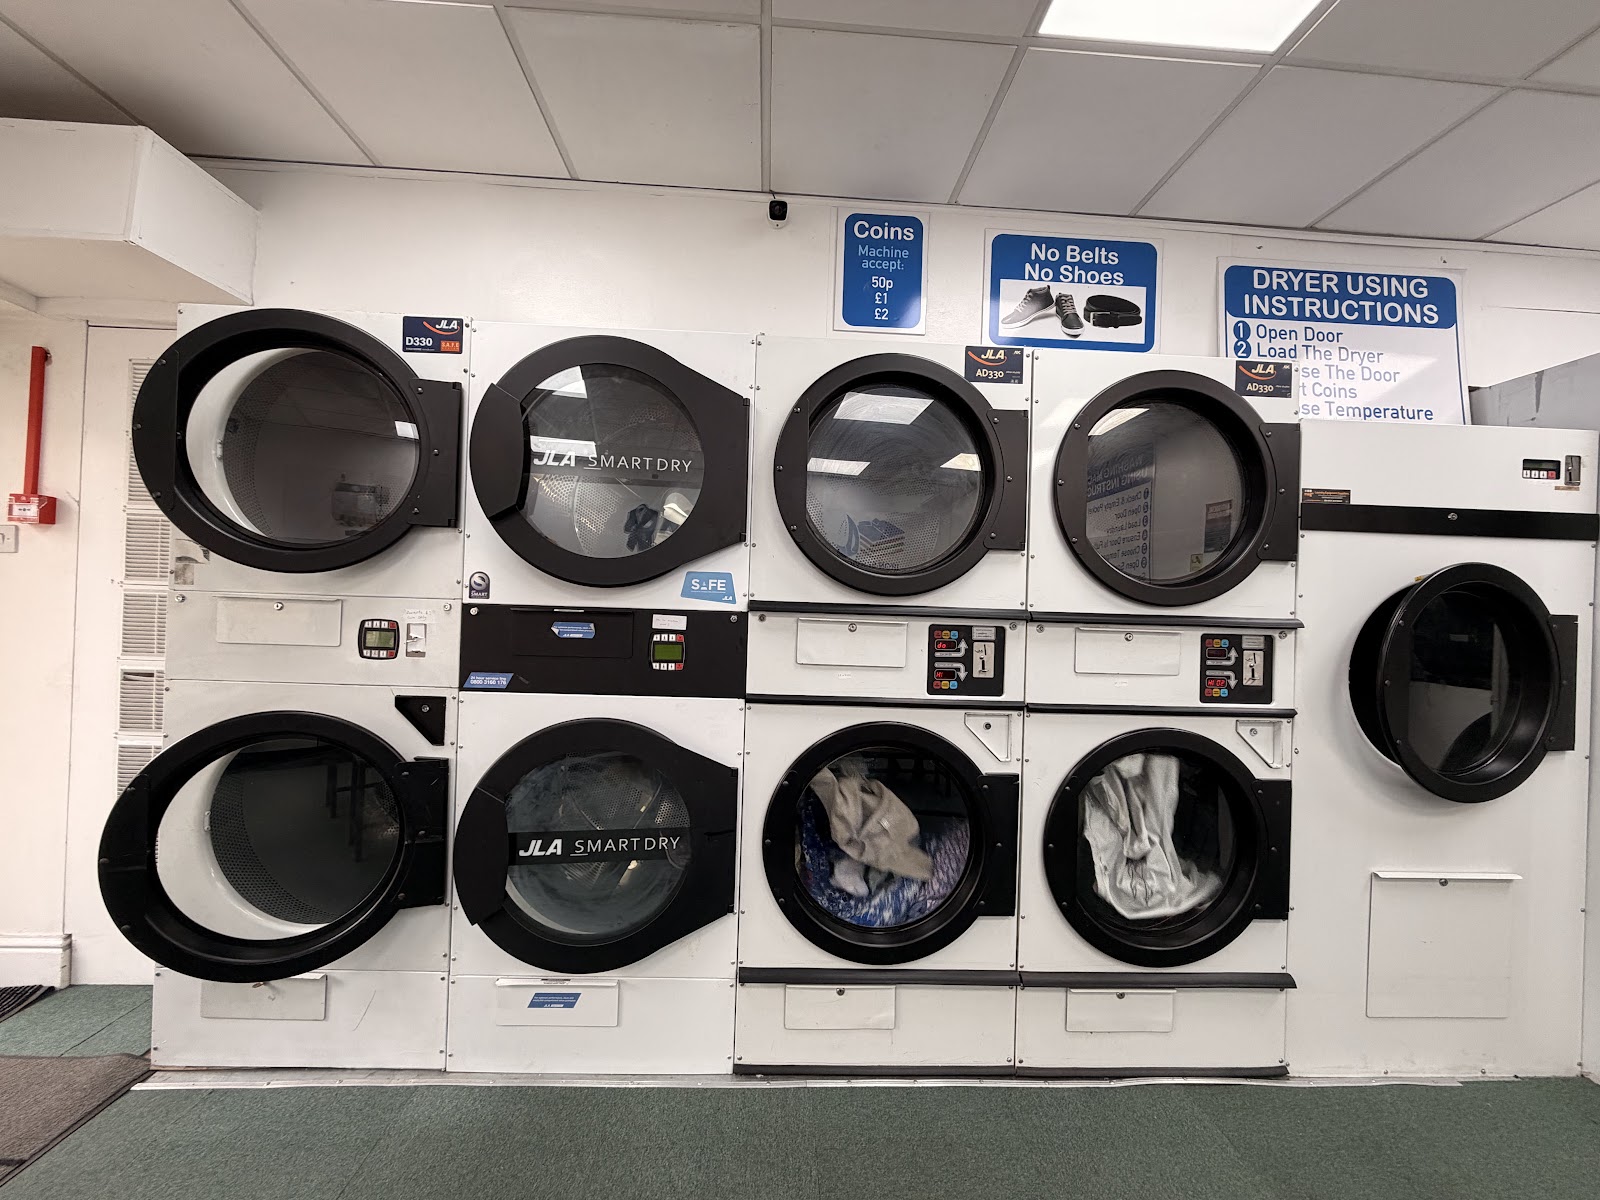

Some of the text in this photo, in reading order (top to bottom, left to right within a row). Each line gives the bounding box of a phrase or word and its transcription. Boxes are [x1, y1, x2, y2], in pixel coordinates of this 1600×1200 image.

[853, 220, 915, 241] Coins
[858, 244, 909, 259] Machine
[1031, 242, 1119, 265] No Belts
[861, 259, 904, 272] accept:
[1024, 262, 1124, 286] No Shoes
[871, 276, 894, 291] 50p
[1253, 269, 1429, 299] DRYER USING
[875, 292, 888, 304] £1
[874, 308, 889, 320] £2
[1244, 294, 1440, 325] INSTRUCTIONS
[435, 320, 459, 330] JLA
[1256, 323, 1298, 343] Open
[1304, 326, 1344, 343] Door
[405, 336, 434, 347] D330
[980, 349, 1006, 360] JLA
[1257, 342, 1298, 359] Load
[1302, 345, 1335, 361] The
[1339, 346, 1384, 367] Dryer
[975, 368, 1005, 379] AD330
[1251, 363, 1276, 374] JLA
[1301, 365, 1401, 383] se The Door
[1246, 382, 1274, 393] AD330
[1312, 382, 1358, 399] Coins
[1301, 401, 1434, 421] se Temperature
[533, 450, 576, 467] JLA
[519, 839, 562, 857] JLA
